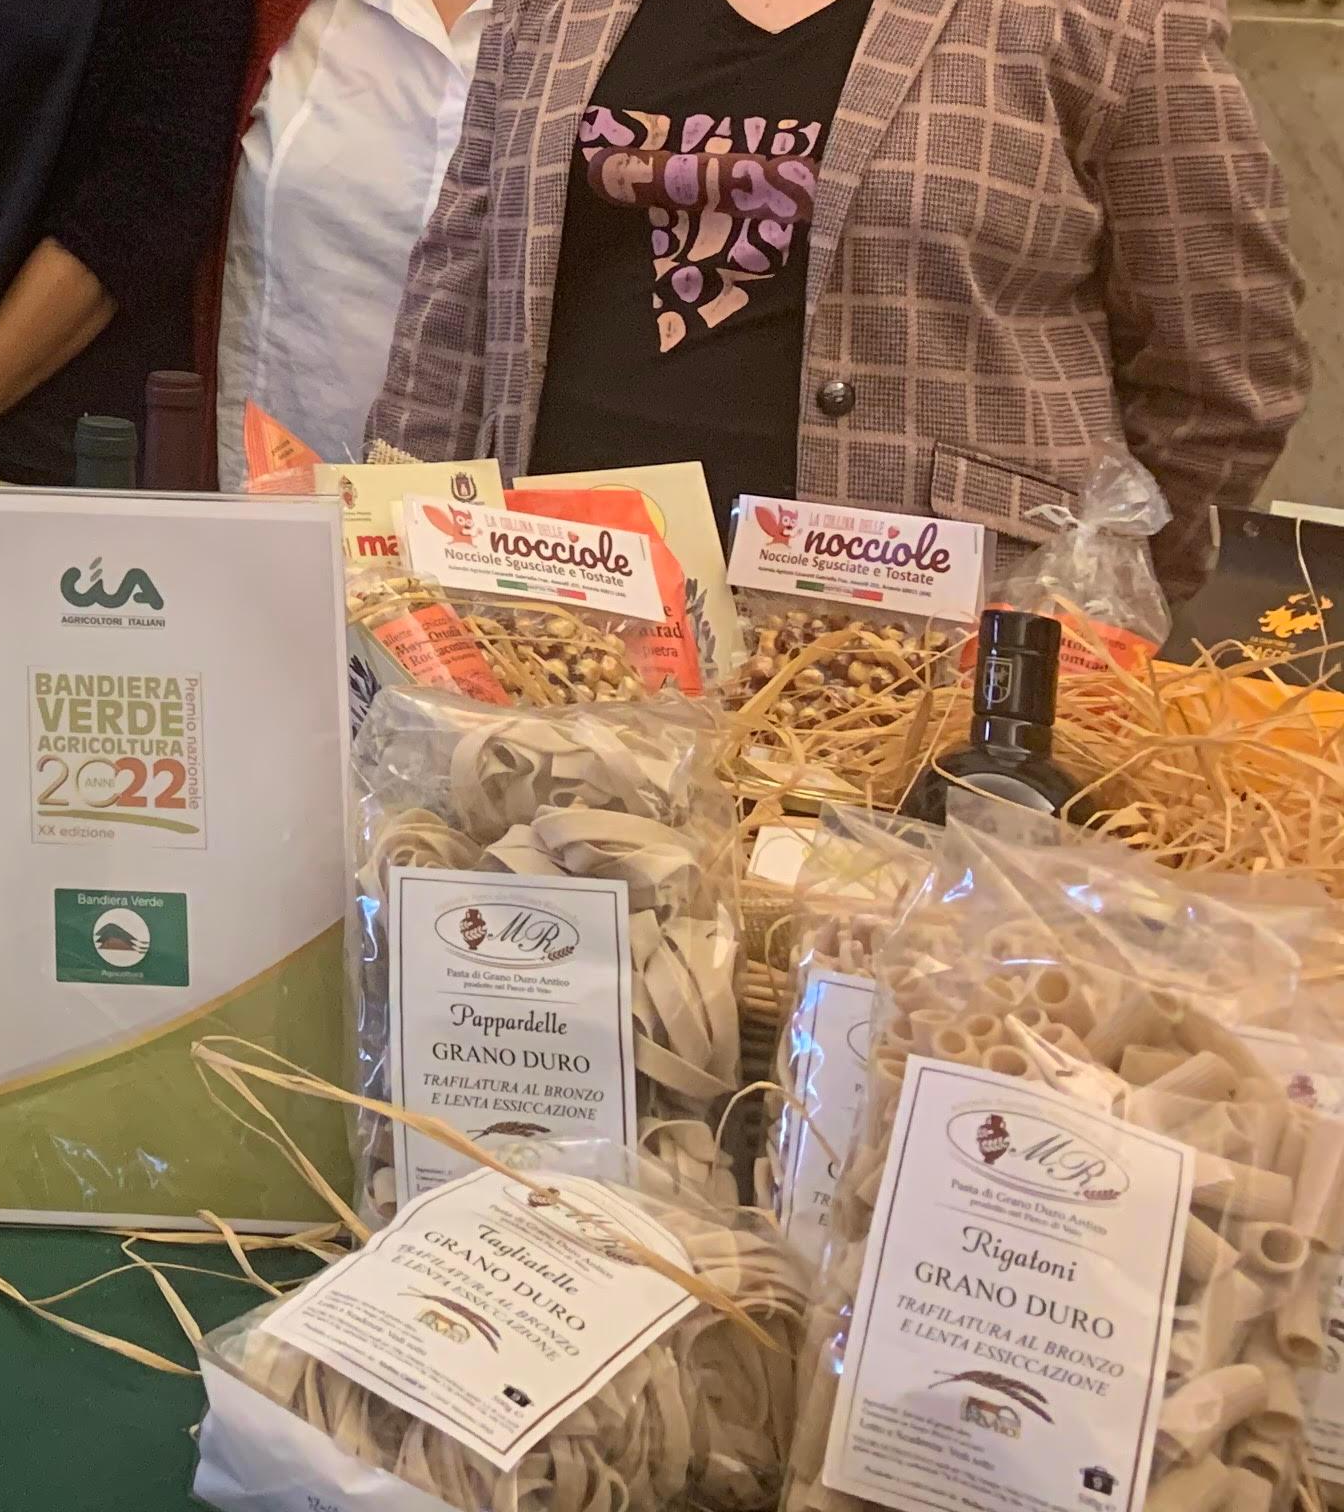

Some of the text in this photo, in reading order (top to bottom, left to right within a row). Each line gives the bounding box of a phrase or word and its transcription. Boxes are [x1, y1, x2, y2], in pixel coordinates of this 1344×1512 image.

[484, 514, 565, 539] LA COLLINA DELLE
[809, 513, 885, 535] LA COLLINA DELLE
[489, 530, 633, 577] nocciole
[804, 522, 951, 573] nocciole
[444, 548, 624, 587] Nocciole Sgusciate e Tostate
[759, 549, 934, 586] Nocciole Sgusciate e Tostate
[61, 616, 165, 628] AGRICOLTORI ITALIANI
[35, 673, 182, 700] BANDIERA
[37, 697, 184, 737] VERDE
[37, 735, 184, 756] AGRICOLTURA
[185, 678, 199, 810] Premio nazionale
[84, 777, 115, 788] ANNI
[38, 824, 115, 838] XX edizione
[77, 893, 164, 907] Bandiera Verde
[447, 968, 569, 987] Pasta di Grano Duro Antico
[450, 1003, 568, 1037] Pappardelle
[432, 1042, 590, 1073] GRANO DURO
[423, 1073, 604, 1102] TRAFILATURA AL BRONZO
[431, 1092, 598, 1120] E LENTA ESSICCAZIONE
[952, 1179, 979, 1194] Pasta
[982, 1185, 994, 1198] di
[996, 1190, 1032, 1210] Grano
[1035, 1202, 1066, 1221] Duro
[818, 1213, 828, 1226] E
[478, 1223, 579, 1295] Tagliatelle
[962, 1226, 1078, 1282] Rigatoni
[424, 1231, 510, 1283] GRANO
[512, 1280, 586, 1331] DURO
[391, 1254, 562, 1363] E LENTA ESSICCAZIONE
[397, 1243, 494, 1298] TRAFILATURA
[490, 1295, 512, 1311] AL
[513, 1305, 580, 1358] BRONZO
[915, 1261, 1114, 1339] GRANO DURO
[896, 1294, 1125, 1378] TRAFILATURA AL BRONZO
[900, 1318, 1110, 1397] E LENTA ESSICCAZIONE
